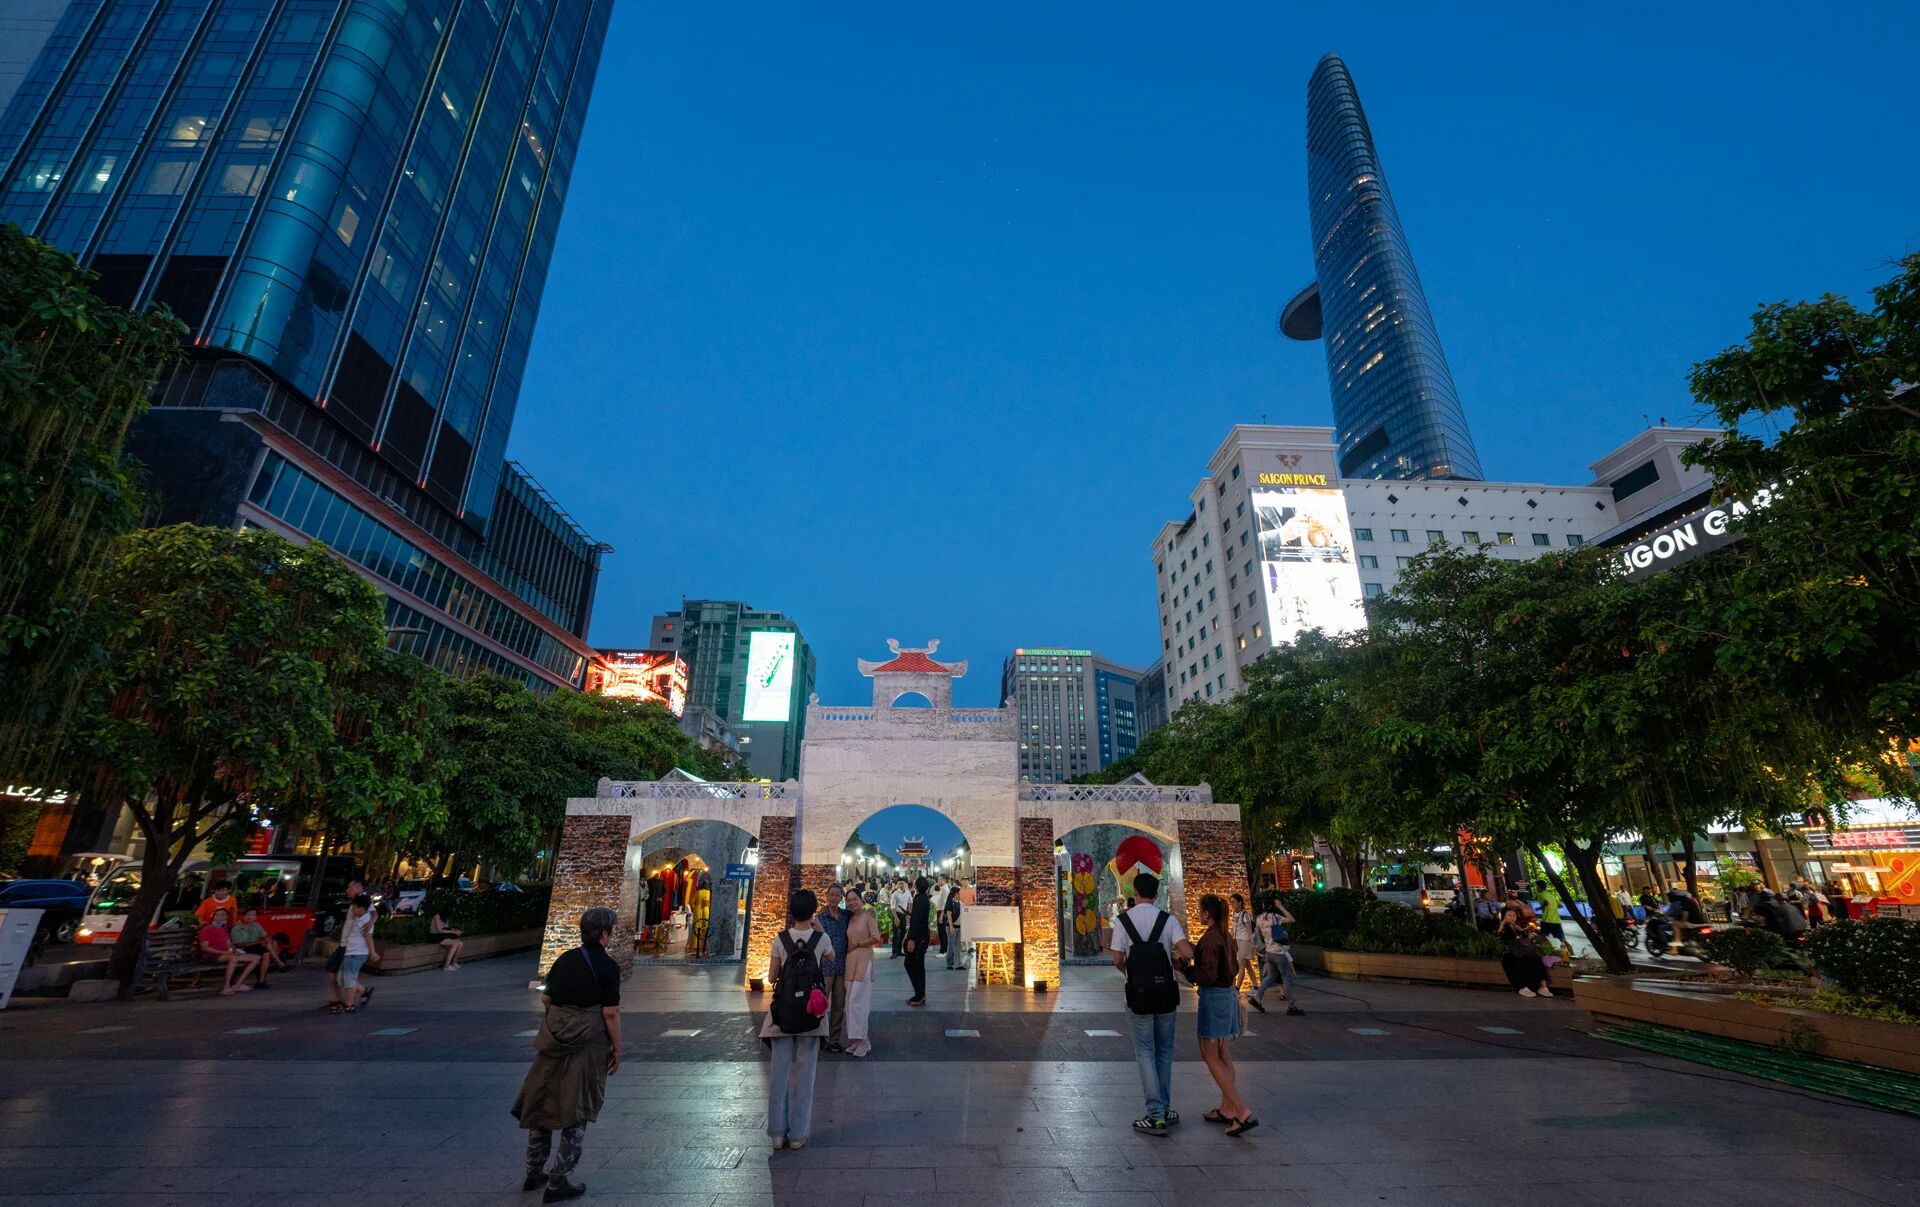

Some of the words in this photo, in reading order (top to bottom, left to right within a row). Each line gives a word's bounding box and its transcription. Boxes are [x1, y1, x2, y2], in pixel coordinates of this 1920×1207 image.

[1259, 472, 1292, 485] SAIGON
[1293, 473, 1327, 486] PRINCE
[1599, 523, 1698, 586] IGON
[1024, 648, 1053, 656] HARBOUR
